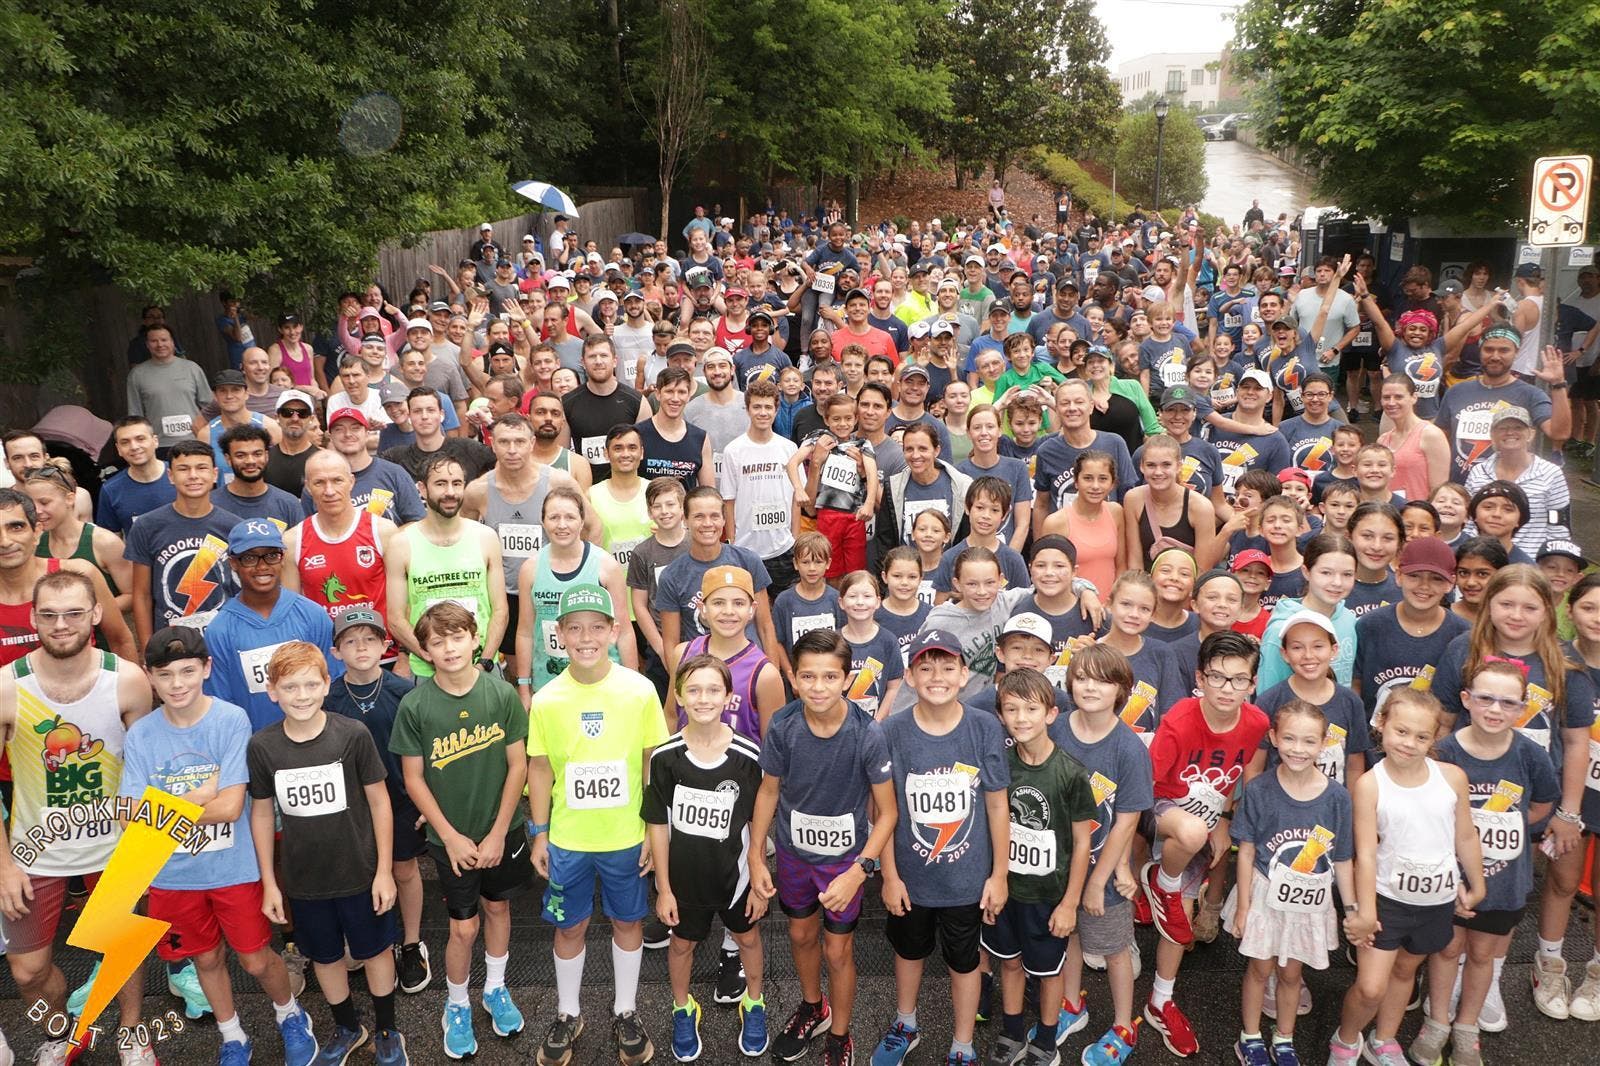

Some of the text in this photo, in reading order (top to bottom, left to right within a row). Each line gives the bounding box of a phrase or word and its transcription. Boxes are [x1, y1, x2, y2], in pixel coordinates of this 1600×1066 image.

[815, 279, 834, 290] 10336
[165, 422, 191, 435] 10380
[1462, 421, 1490, 435] 1088
[646, 467, 694, 476] multisport
[742, 463, 778, 475] MARIST
[827, 465, 857, 487] 10926
[755, 511, 786, 525] 10890
[502, 536, 540, 551] 10564
[413, 571, 482, 585] PEACHTREE CITY
[430, 721, 506, 761] Athletics
[47, 762, 103, 793] BIG
[574, 777, 621, 799] 6462
[47, 789, 104, 809] PEACH
[287, 781, 336, 807] 5950
[909, 789, 967, 814] 10481
[1015, 787, 1044, 805] ASHFORD
[1039, 801, 1049, 820] PARK
[677, 803, 731, 829] 10959
[796, 827, 852, 848] 10925
[947, 842, 971, 864] 2023
[1397, 871, 1455, 894] 10374
[1278, 883, 1326, 906] 9250
